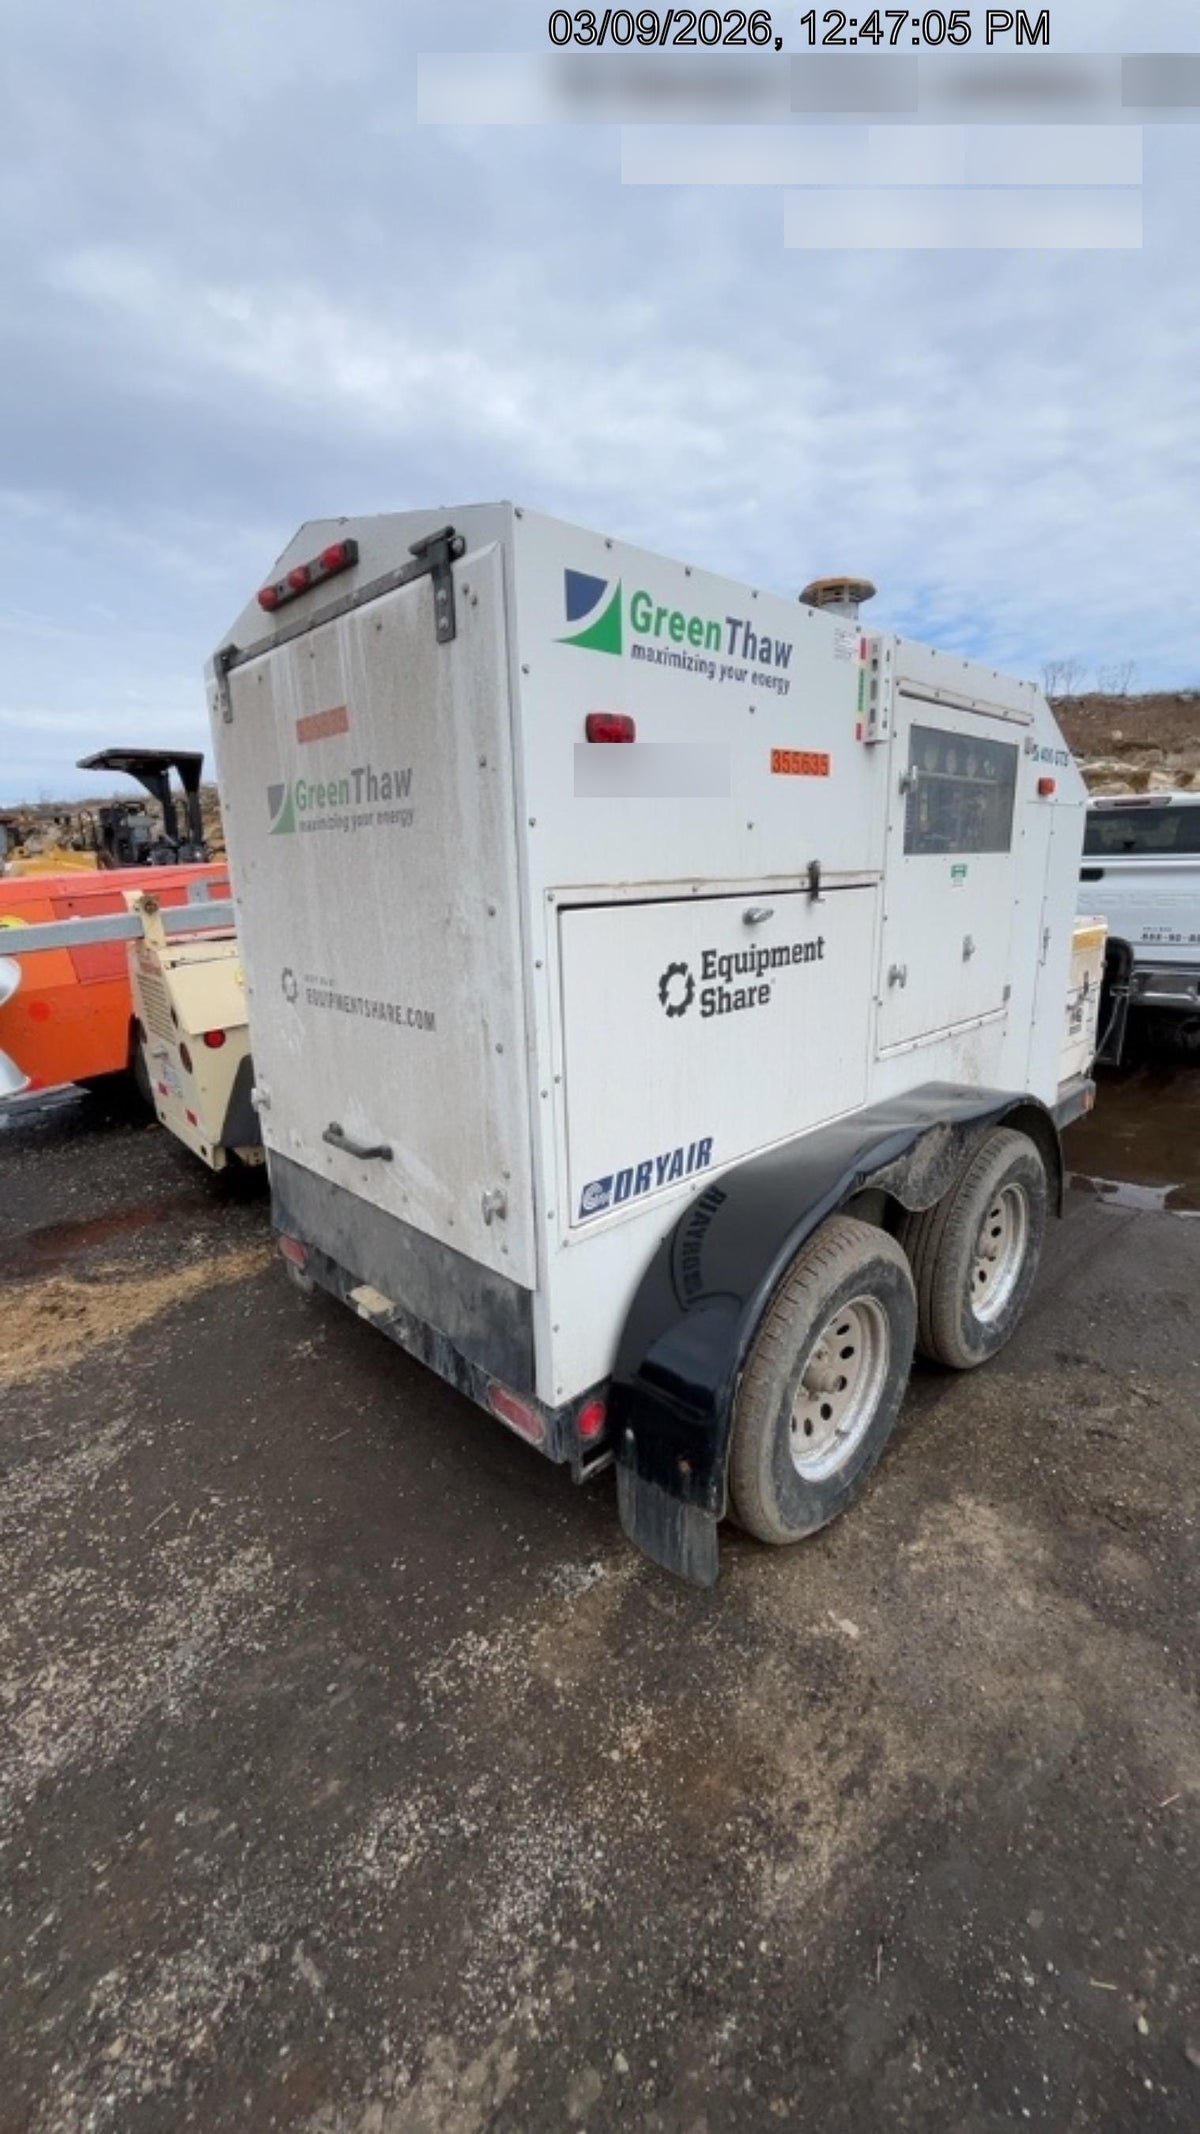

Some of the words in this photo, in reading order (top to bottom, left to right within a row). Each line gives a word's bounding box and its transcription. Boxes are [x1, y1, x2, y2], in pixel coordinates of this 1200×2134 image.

[629, 589, 793, 669] GreenThaw
[630, 641, 717, 679] maximizing
[718, 663, 748, 684] your
[750, 672, 792, 696] energy
[295, 764, 413, 811] GreenThaw
[298, 812, 350, 833] maximizing
[350, 811, 374, 833] your
[376, 808, 415, 829] energy
[701, 935, 825, 983] Equipment
[305, 988, 437, 1032] EQUIPMENTSHARE.COM
[700, 983, 771, 1018] Share
[612, 1136, 715, 1204] DRYAIR
